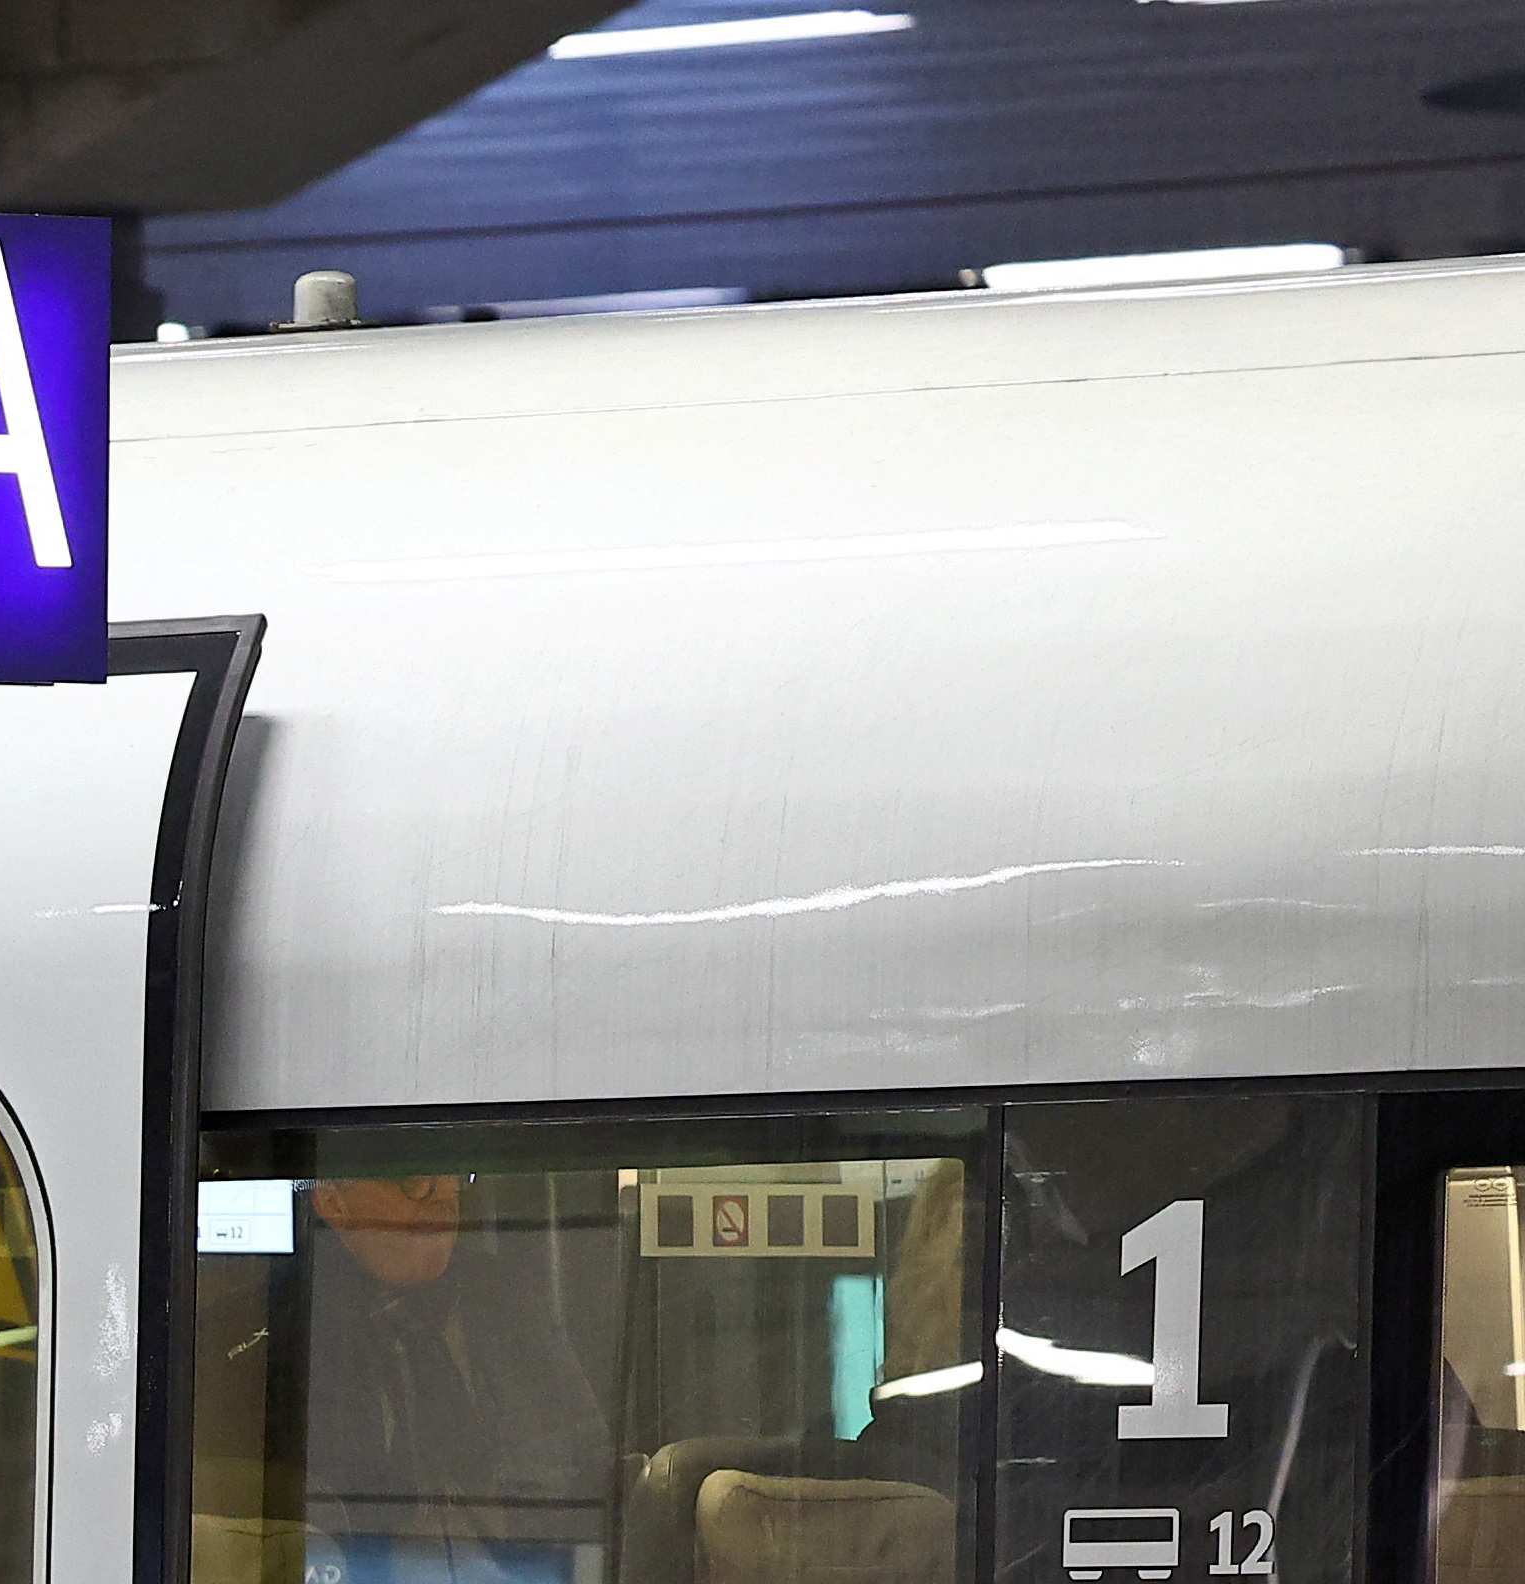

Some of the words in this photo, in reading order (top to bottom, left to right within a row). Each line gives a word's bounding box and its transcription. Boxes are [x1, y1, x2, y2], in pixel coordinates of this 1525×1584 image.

[230, 1225, 244, 1239] 12
[1118, 1199, 1229, 1438] 1
[1209, 1510, 1274, 1575] 12
